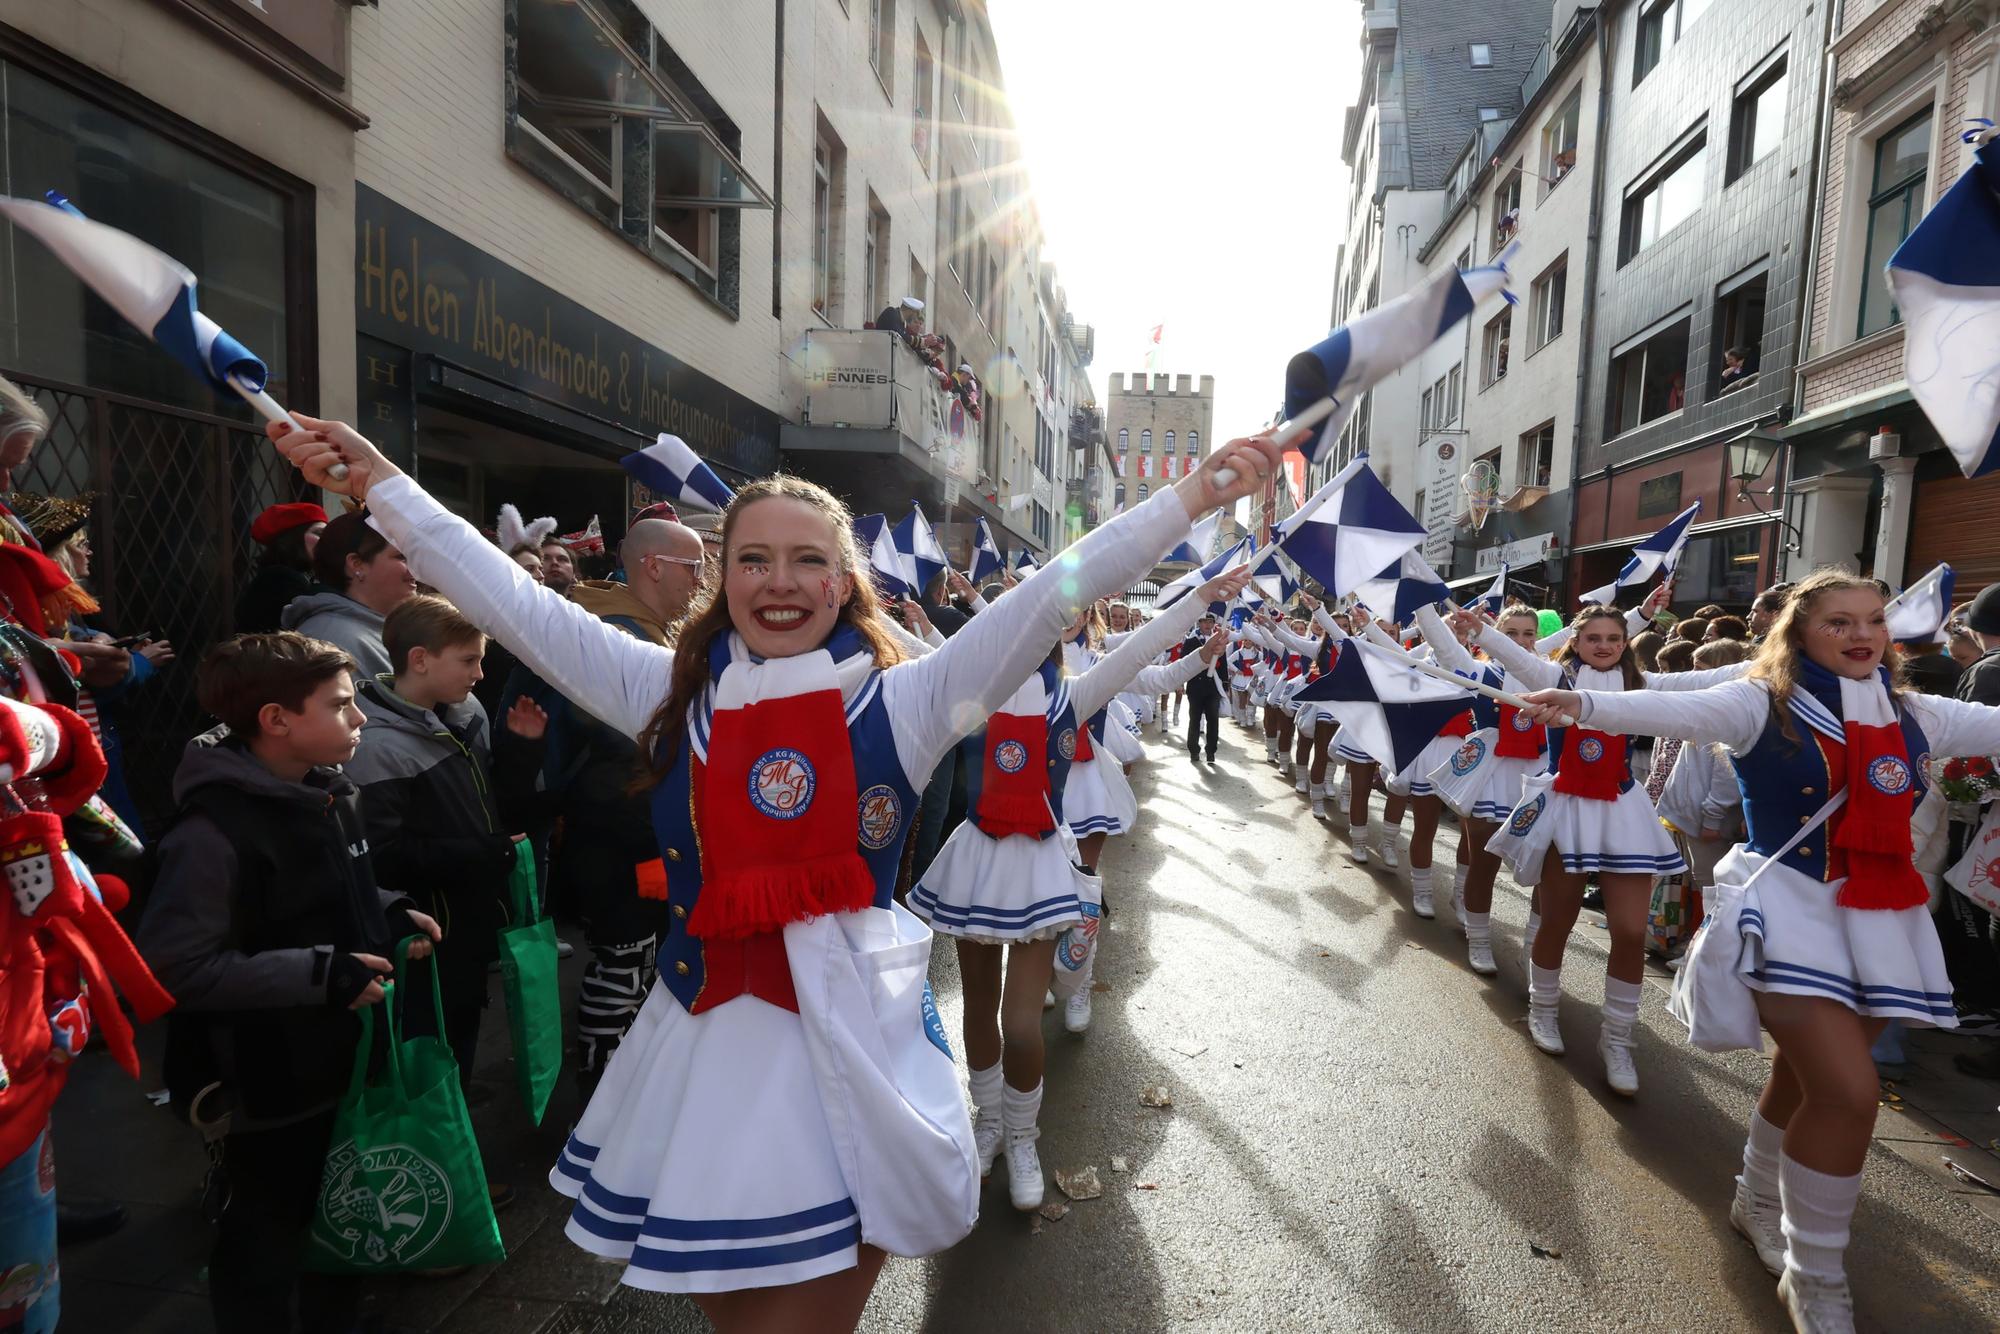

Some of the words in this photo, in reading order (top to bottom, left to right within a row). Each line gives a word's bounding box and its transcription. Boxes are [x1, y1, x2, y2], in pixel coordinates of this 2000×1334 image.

[361, 219, 460, 344] Helen
[473, 277, 611, 405] Abendmode
[618, 351, 632, 415] &
[813, 372, 888, 384] HENNES
